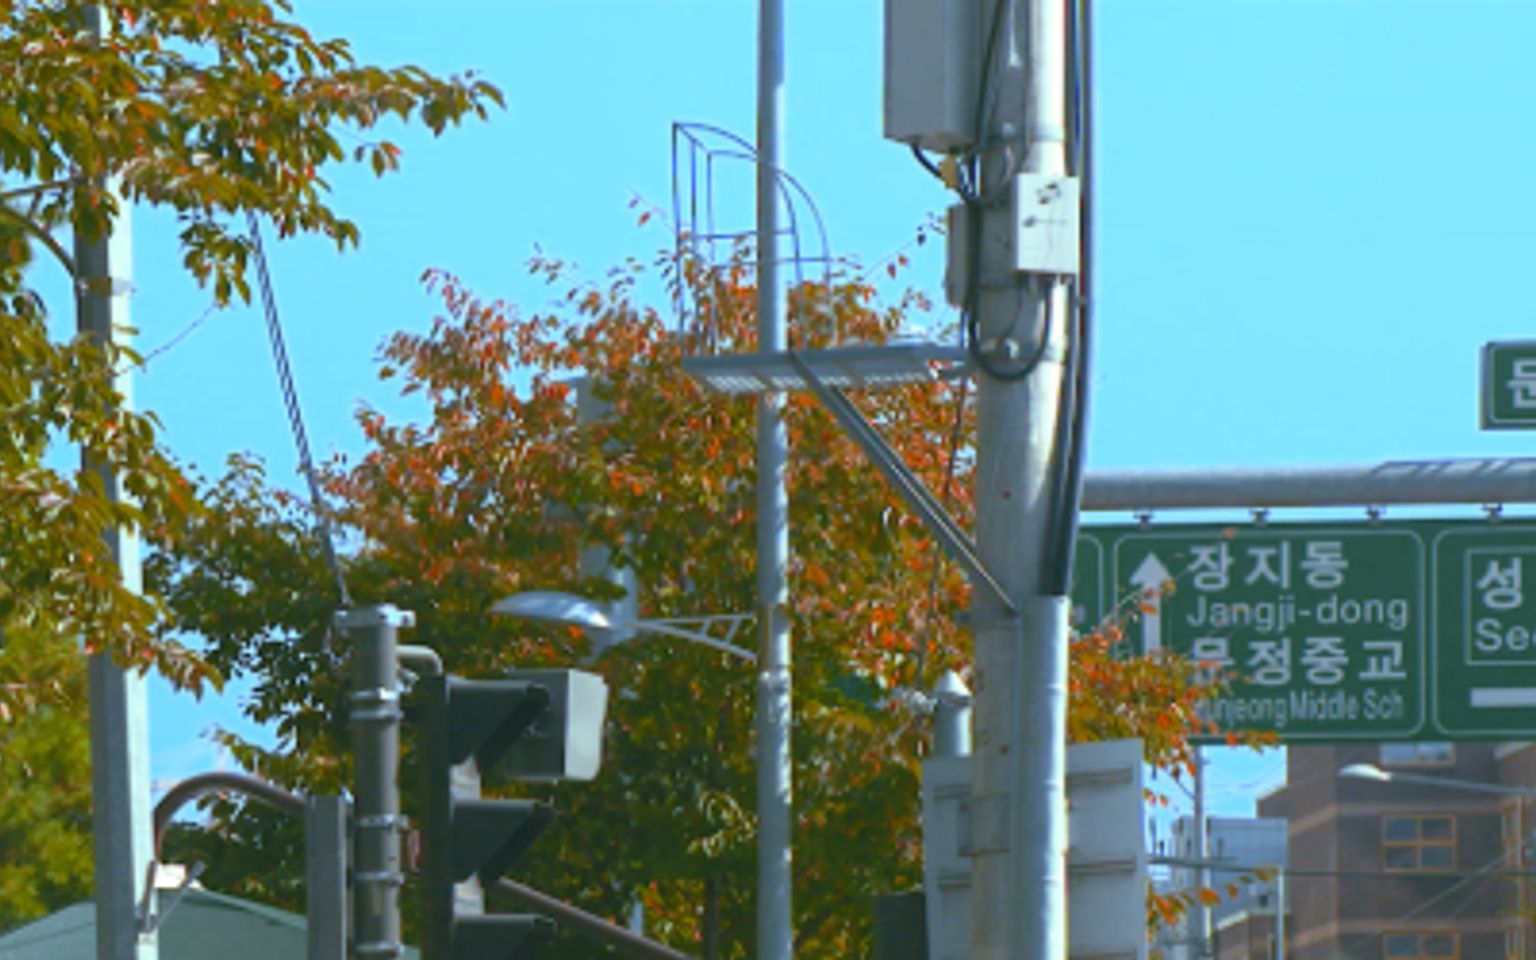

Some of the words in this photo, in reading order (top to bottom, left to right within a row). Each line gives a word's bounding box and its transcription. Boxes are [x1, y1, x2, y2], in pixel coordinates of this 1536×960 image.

[1187, 541, 1349, 592] 장지동
[1476, 556, 1523, 609] 성
[1186, 595, 1408, 634] Jangji-dong
[1475, 618, 1536, 652] Se
